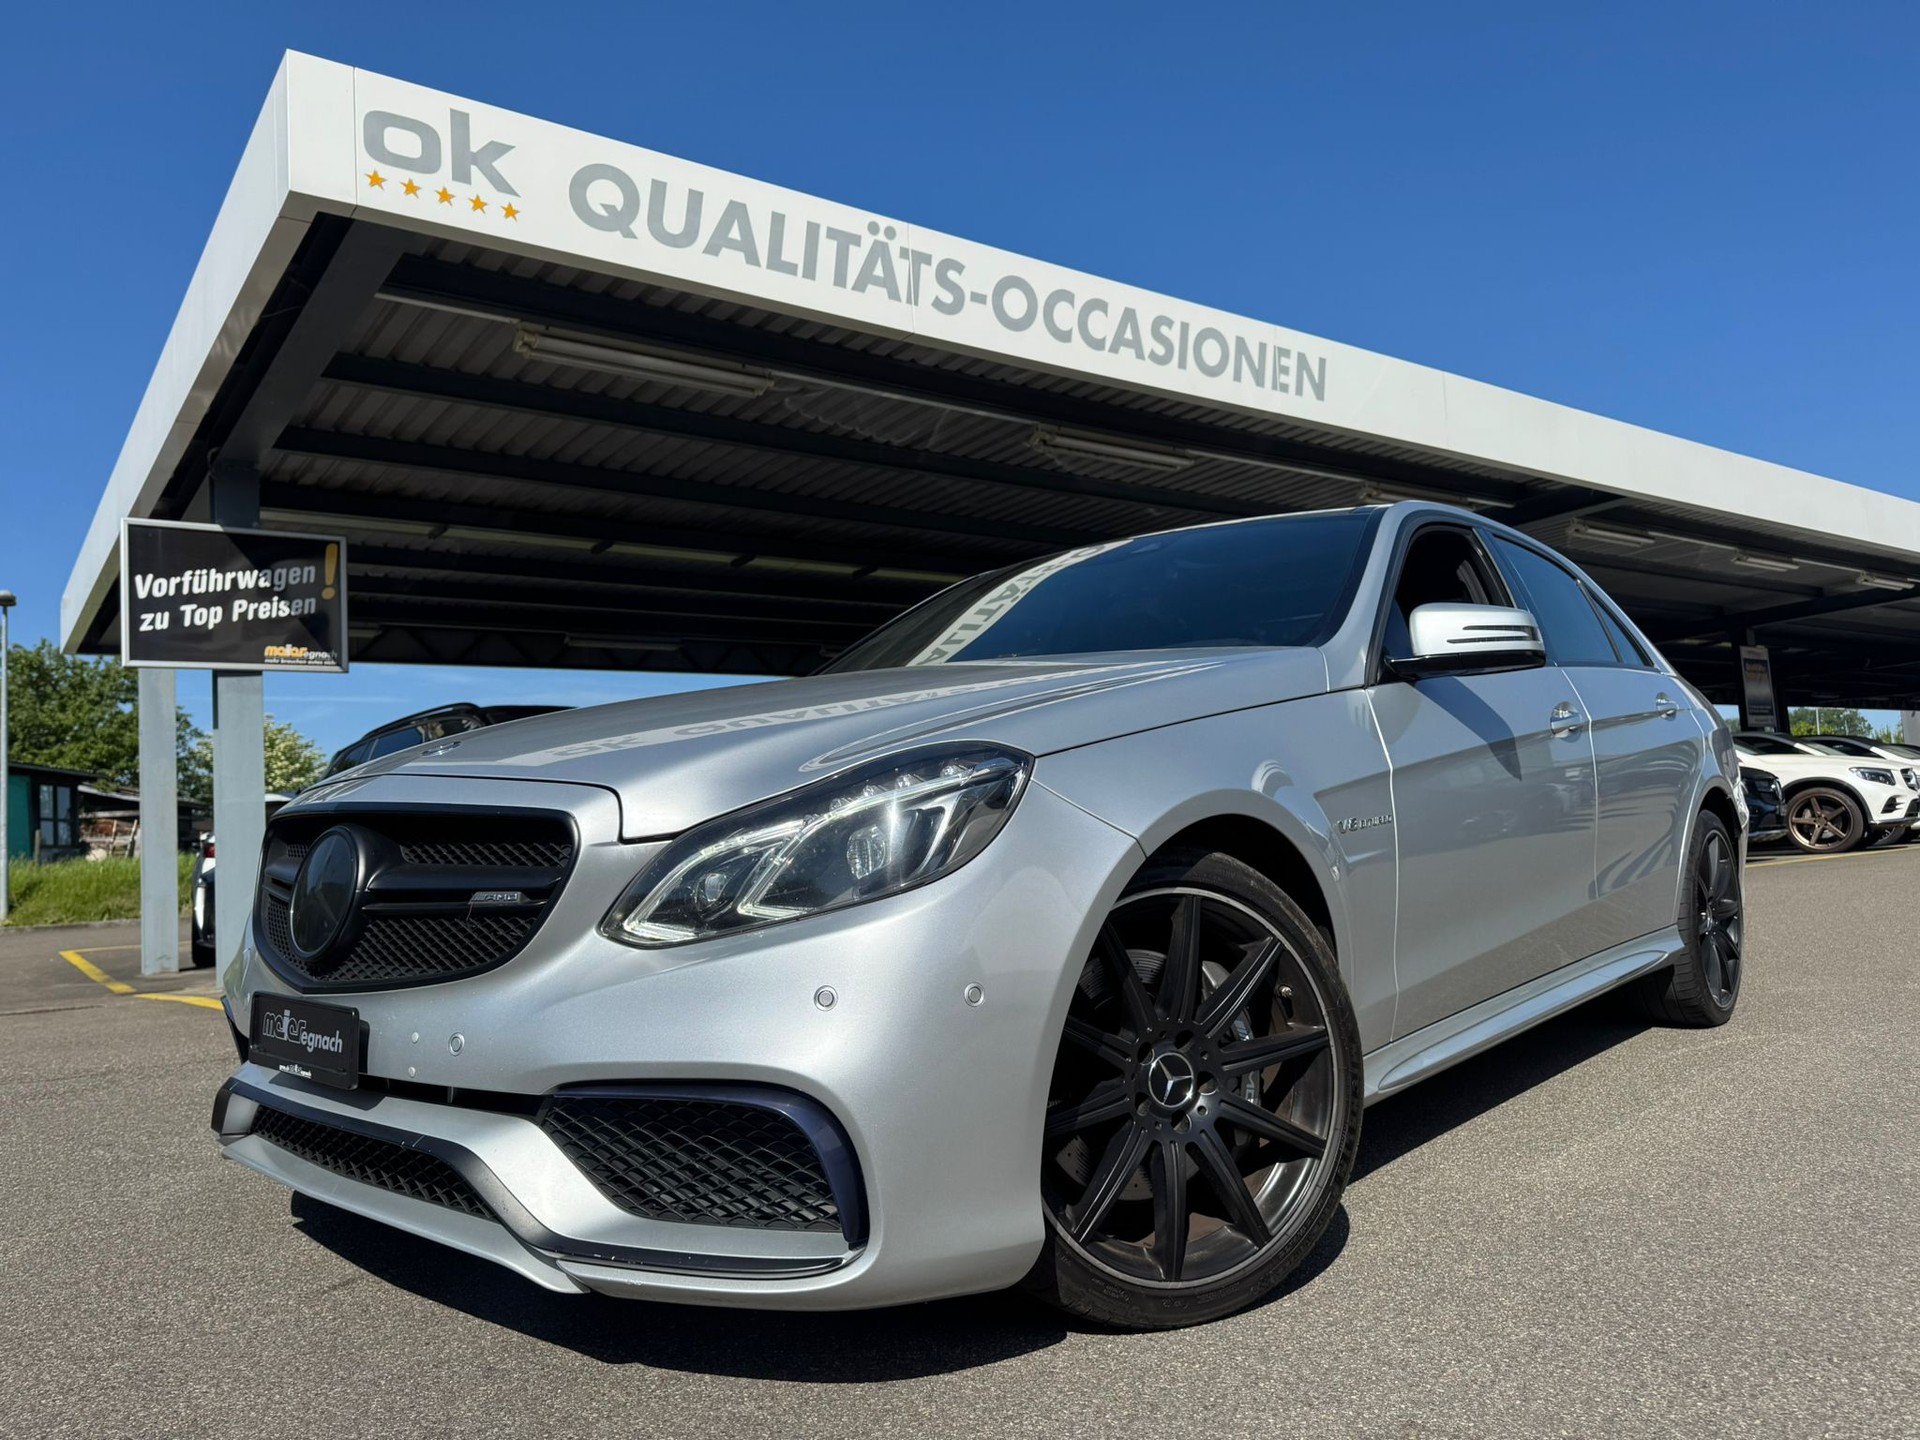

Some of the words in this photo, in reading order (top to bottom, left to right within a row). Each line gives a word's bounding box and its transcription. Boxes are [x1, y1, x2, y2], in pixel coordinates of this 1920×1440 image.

[363, 107, 521, 198] ok
[568, 162, 1327, 402] QUALITÄTS-OCCASIONEN
[134, 564, 316, 600] Vorführwagen
[139, 610, 170, 632] zu
[180, 603, 223, 630] Top
[232, 595, 317, 623] Preisen
